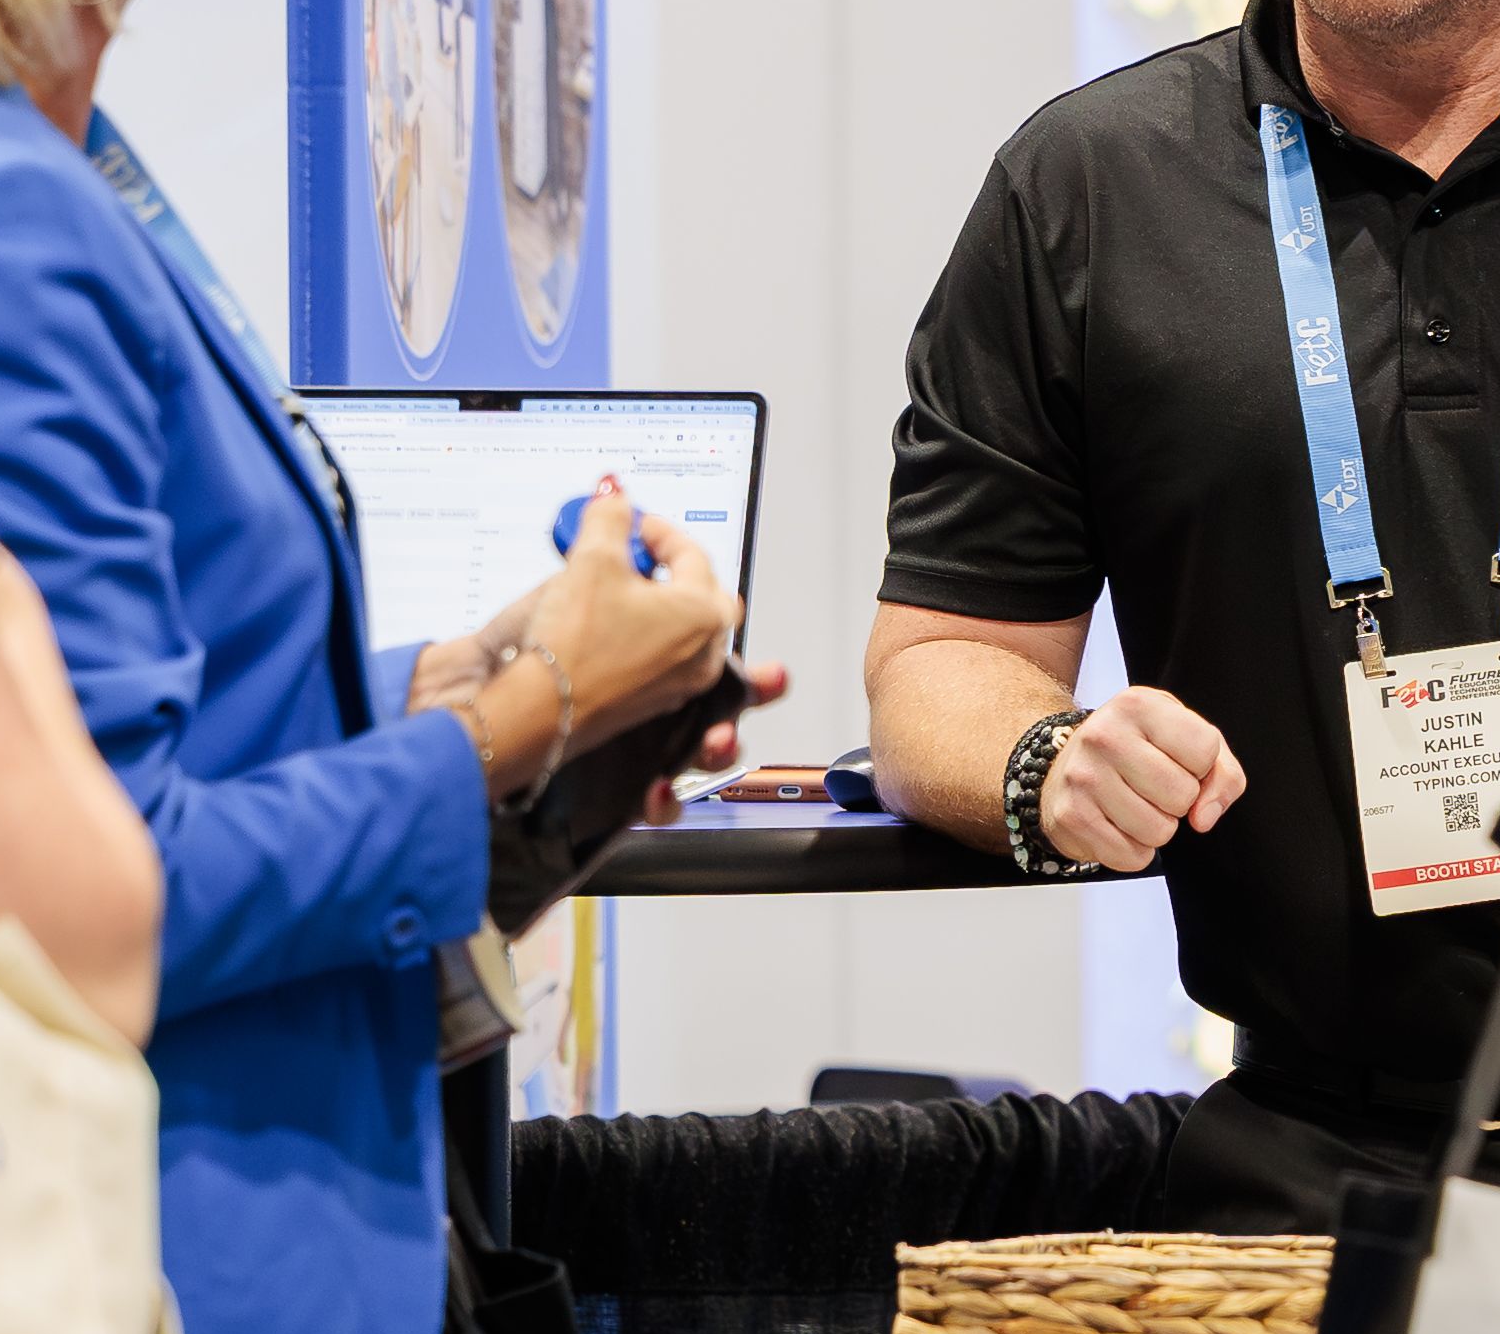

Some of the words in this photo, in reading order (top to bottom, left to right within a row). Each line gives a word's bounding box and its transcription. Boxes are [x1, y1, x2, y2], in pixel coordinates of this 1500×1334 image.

[1421, 711, 1483, 733] JUSTIN
[1424, 734, 1485, 754] KAHLE
[1379, 759, 1449, 780] ACCOUNT
[1363, 804, 1395, 817] 206577
[1416, 862, 1470, 882] BOOTH
